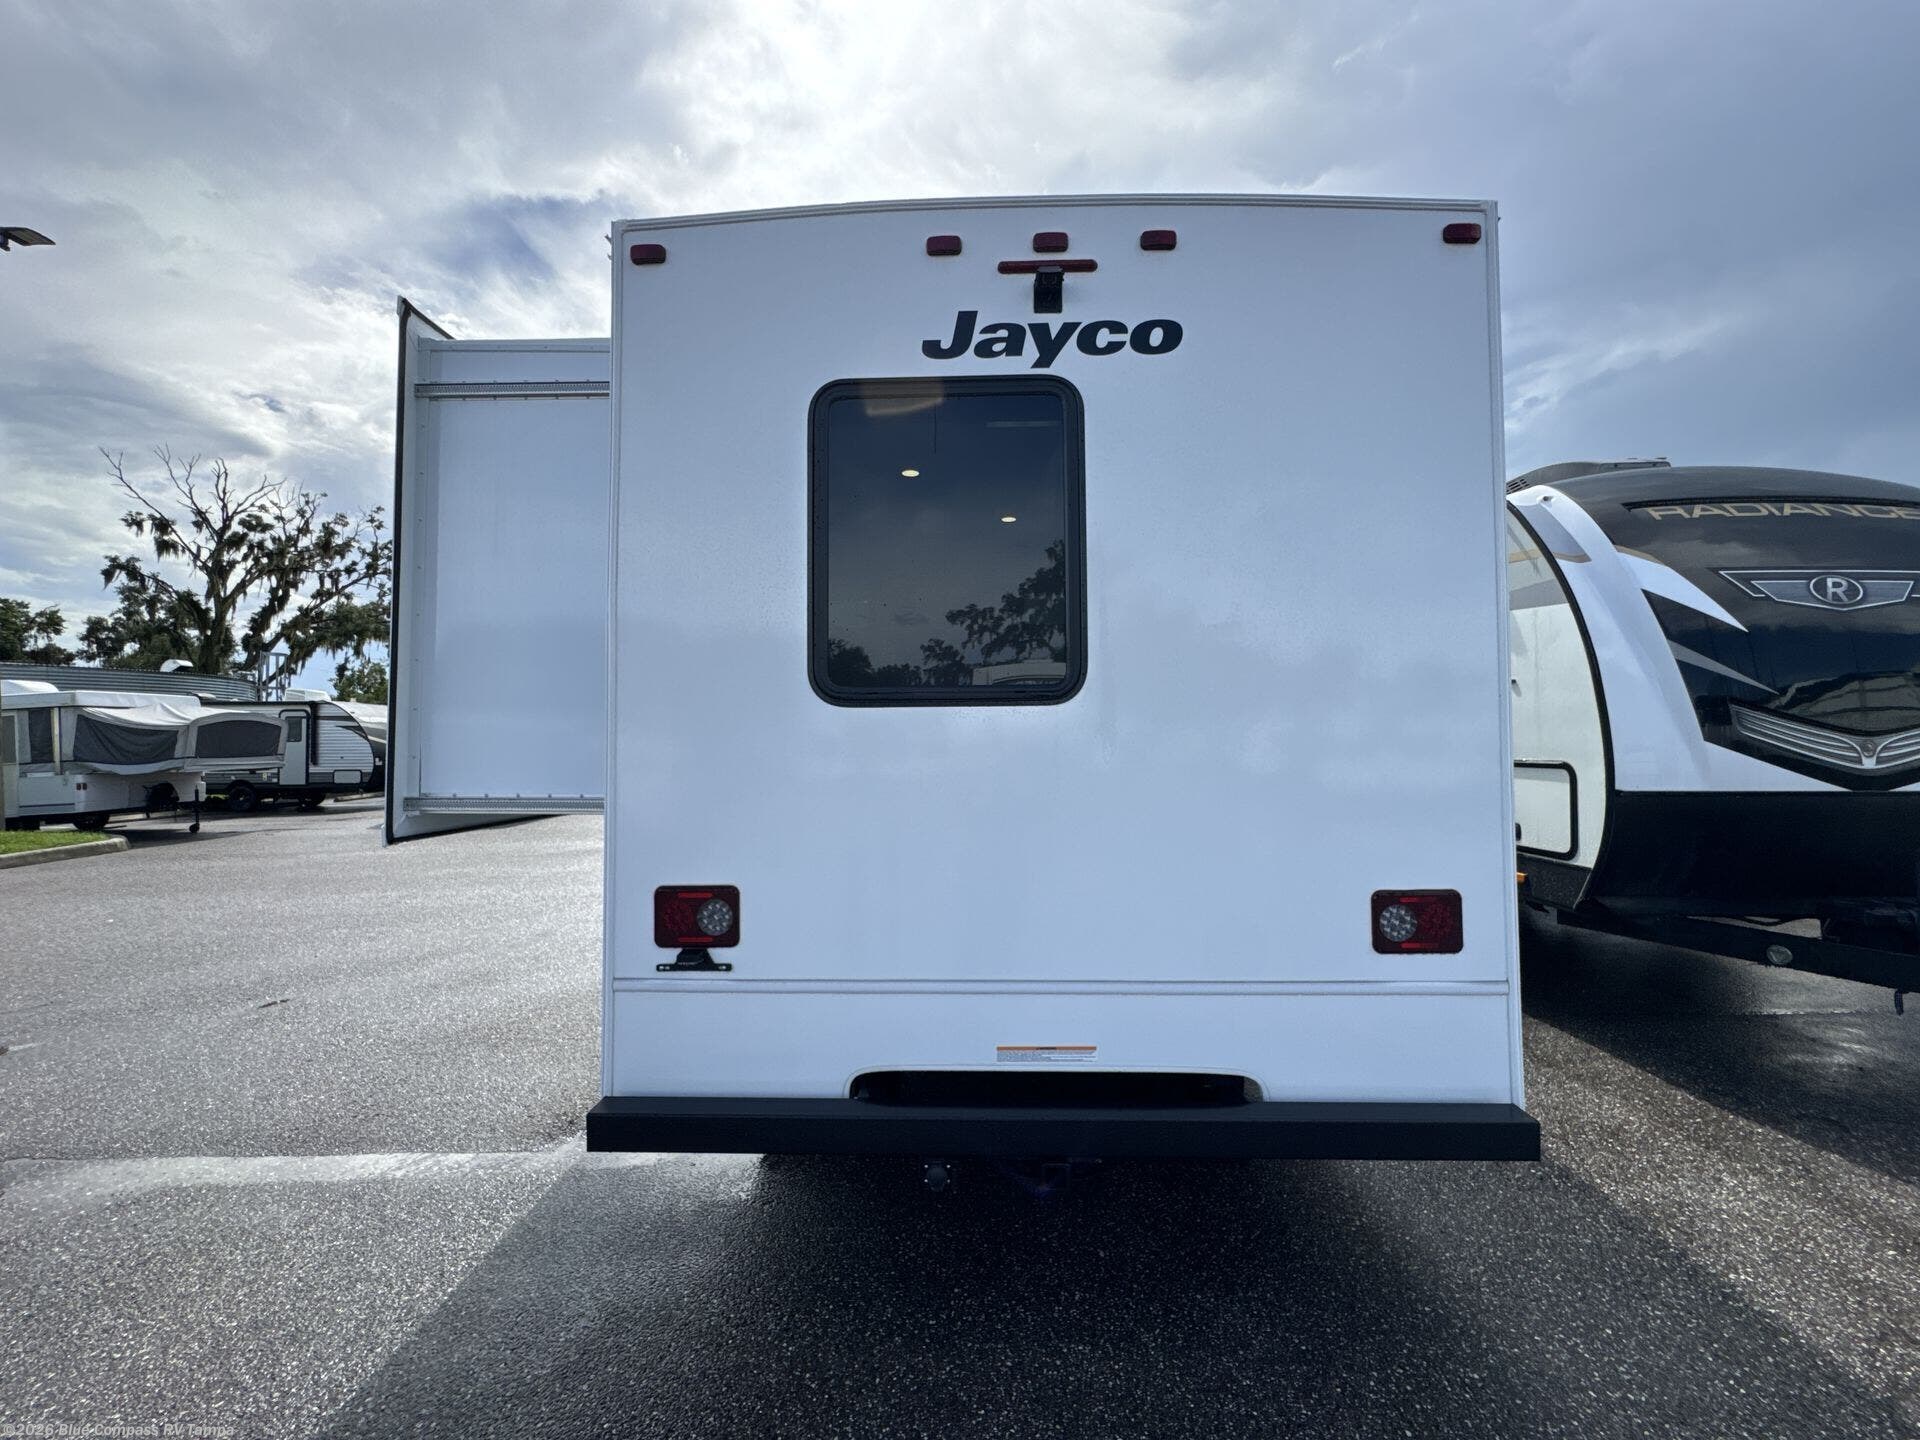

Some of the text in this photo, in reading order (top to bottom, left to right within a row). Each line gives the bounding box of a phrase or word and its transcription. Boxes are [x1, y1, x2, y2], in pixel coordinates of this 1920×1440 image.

[921, 310, 1184, 369] Jayco
[1647, 502, 1920, 521] RADIANCE
[1826, 577, 1849, 602] R
